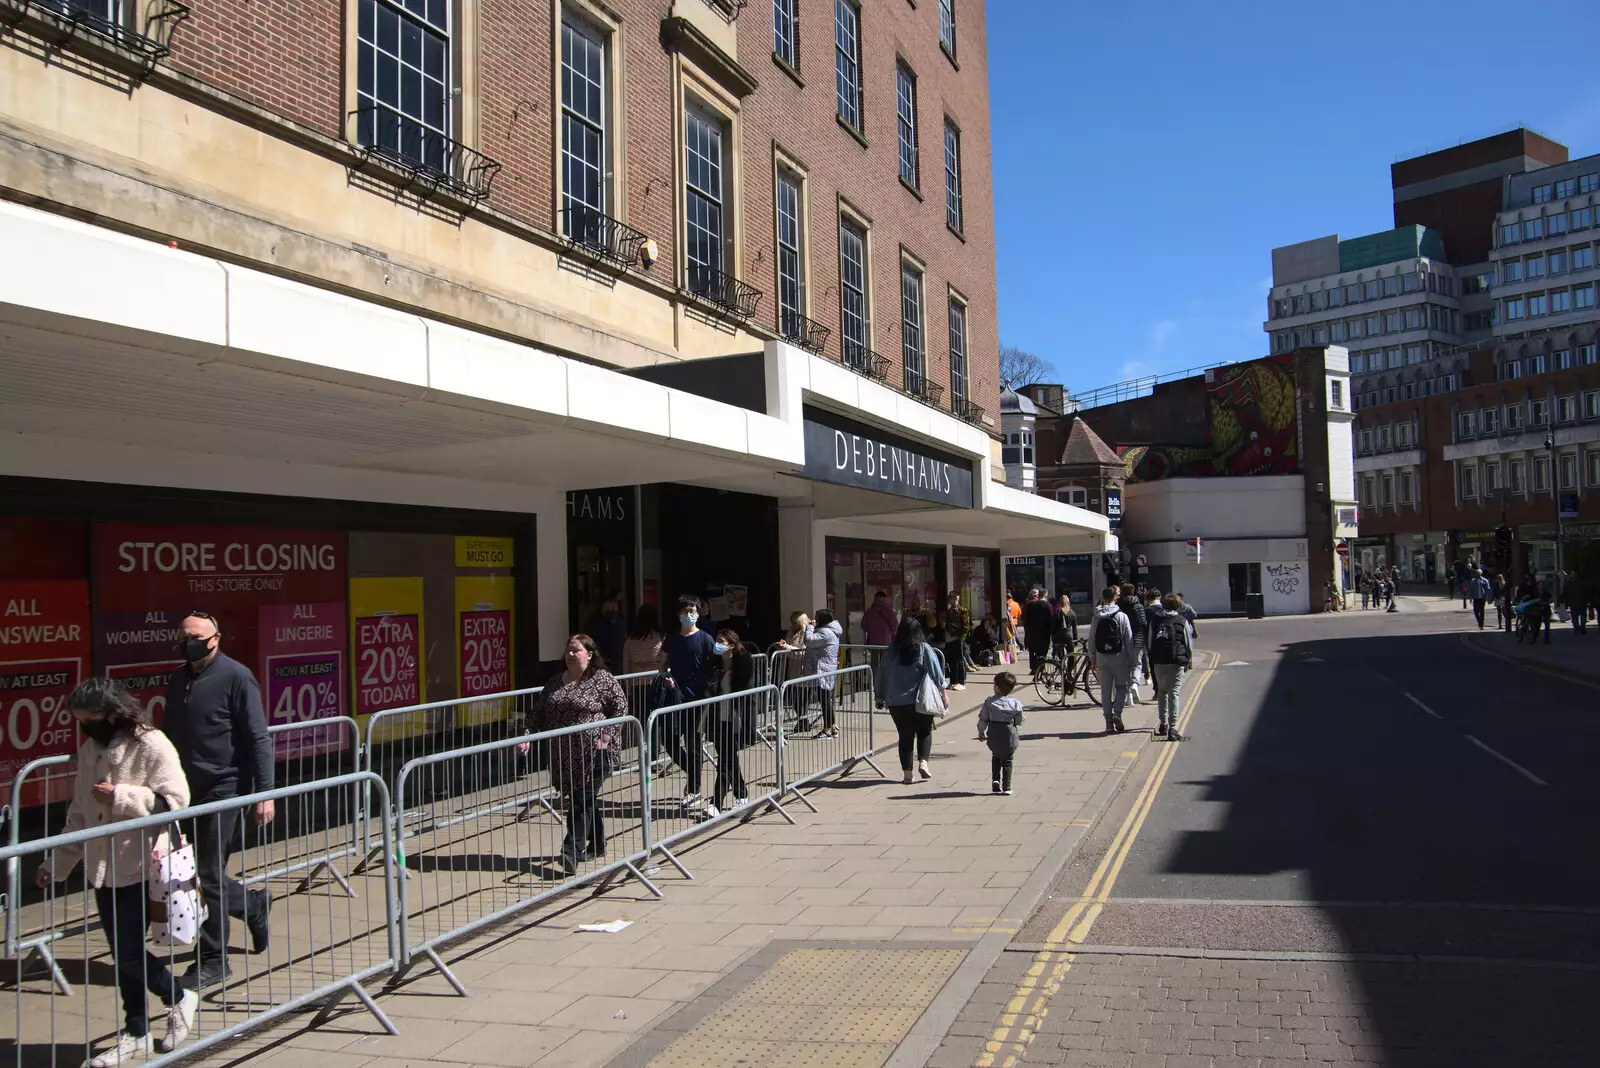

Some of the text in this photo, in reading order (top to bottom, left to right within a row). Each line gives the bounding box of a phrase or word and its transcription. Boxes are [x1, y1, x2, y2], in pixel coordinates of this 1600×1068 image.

[835, 430, 950, 494] DEBENHAMS
[118, 541, 336, 572] STORE CLOSING
[467, 551, 504, 563] MUST GO
[189, 578, 283, 592] THIS STORE ONLY
[5, 598, 42, 616] ALL
[292, 604, 317, 620] ALL
[145, 611, 167, 623] ALL
[276, 625, 333, 642] LINGERIE
[360, 622, 414, 645] EXTRA
[464, 617, 506, 637] EXTRA
[464, 638, 506, 673] 20%
[276, 663, 334, 677] NOW AT LEAST
[361, 645, 417, 686] 20%
[492, 660, 507, 670] OFF
[11, 676, 29, 688] AT
[31, 673, 69, 687] LEAST
[148, 676, 160, 688] AT
[397, 669, 416, 681] OFF
[464, 672, 508, 692] TODAY!
[274, 680, 337, 724] 40%
[362, 684, 416, 707] TODAY!
[317, 707, 336, 719] OFF
[41, 728, 71, 746] OFF
